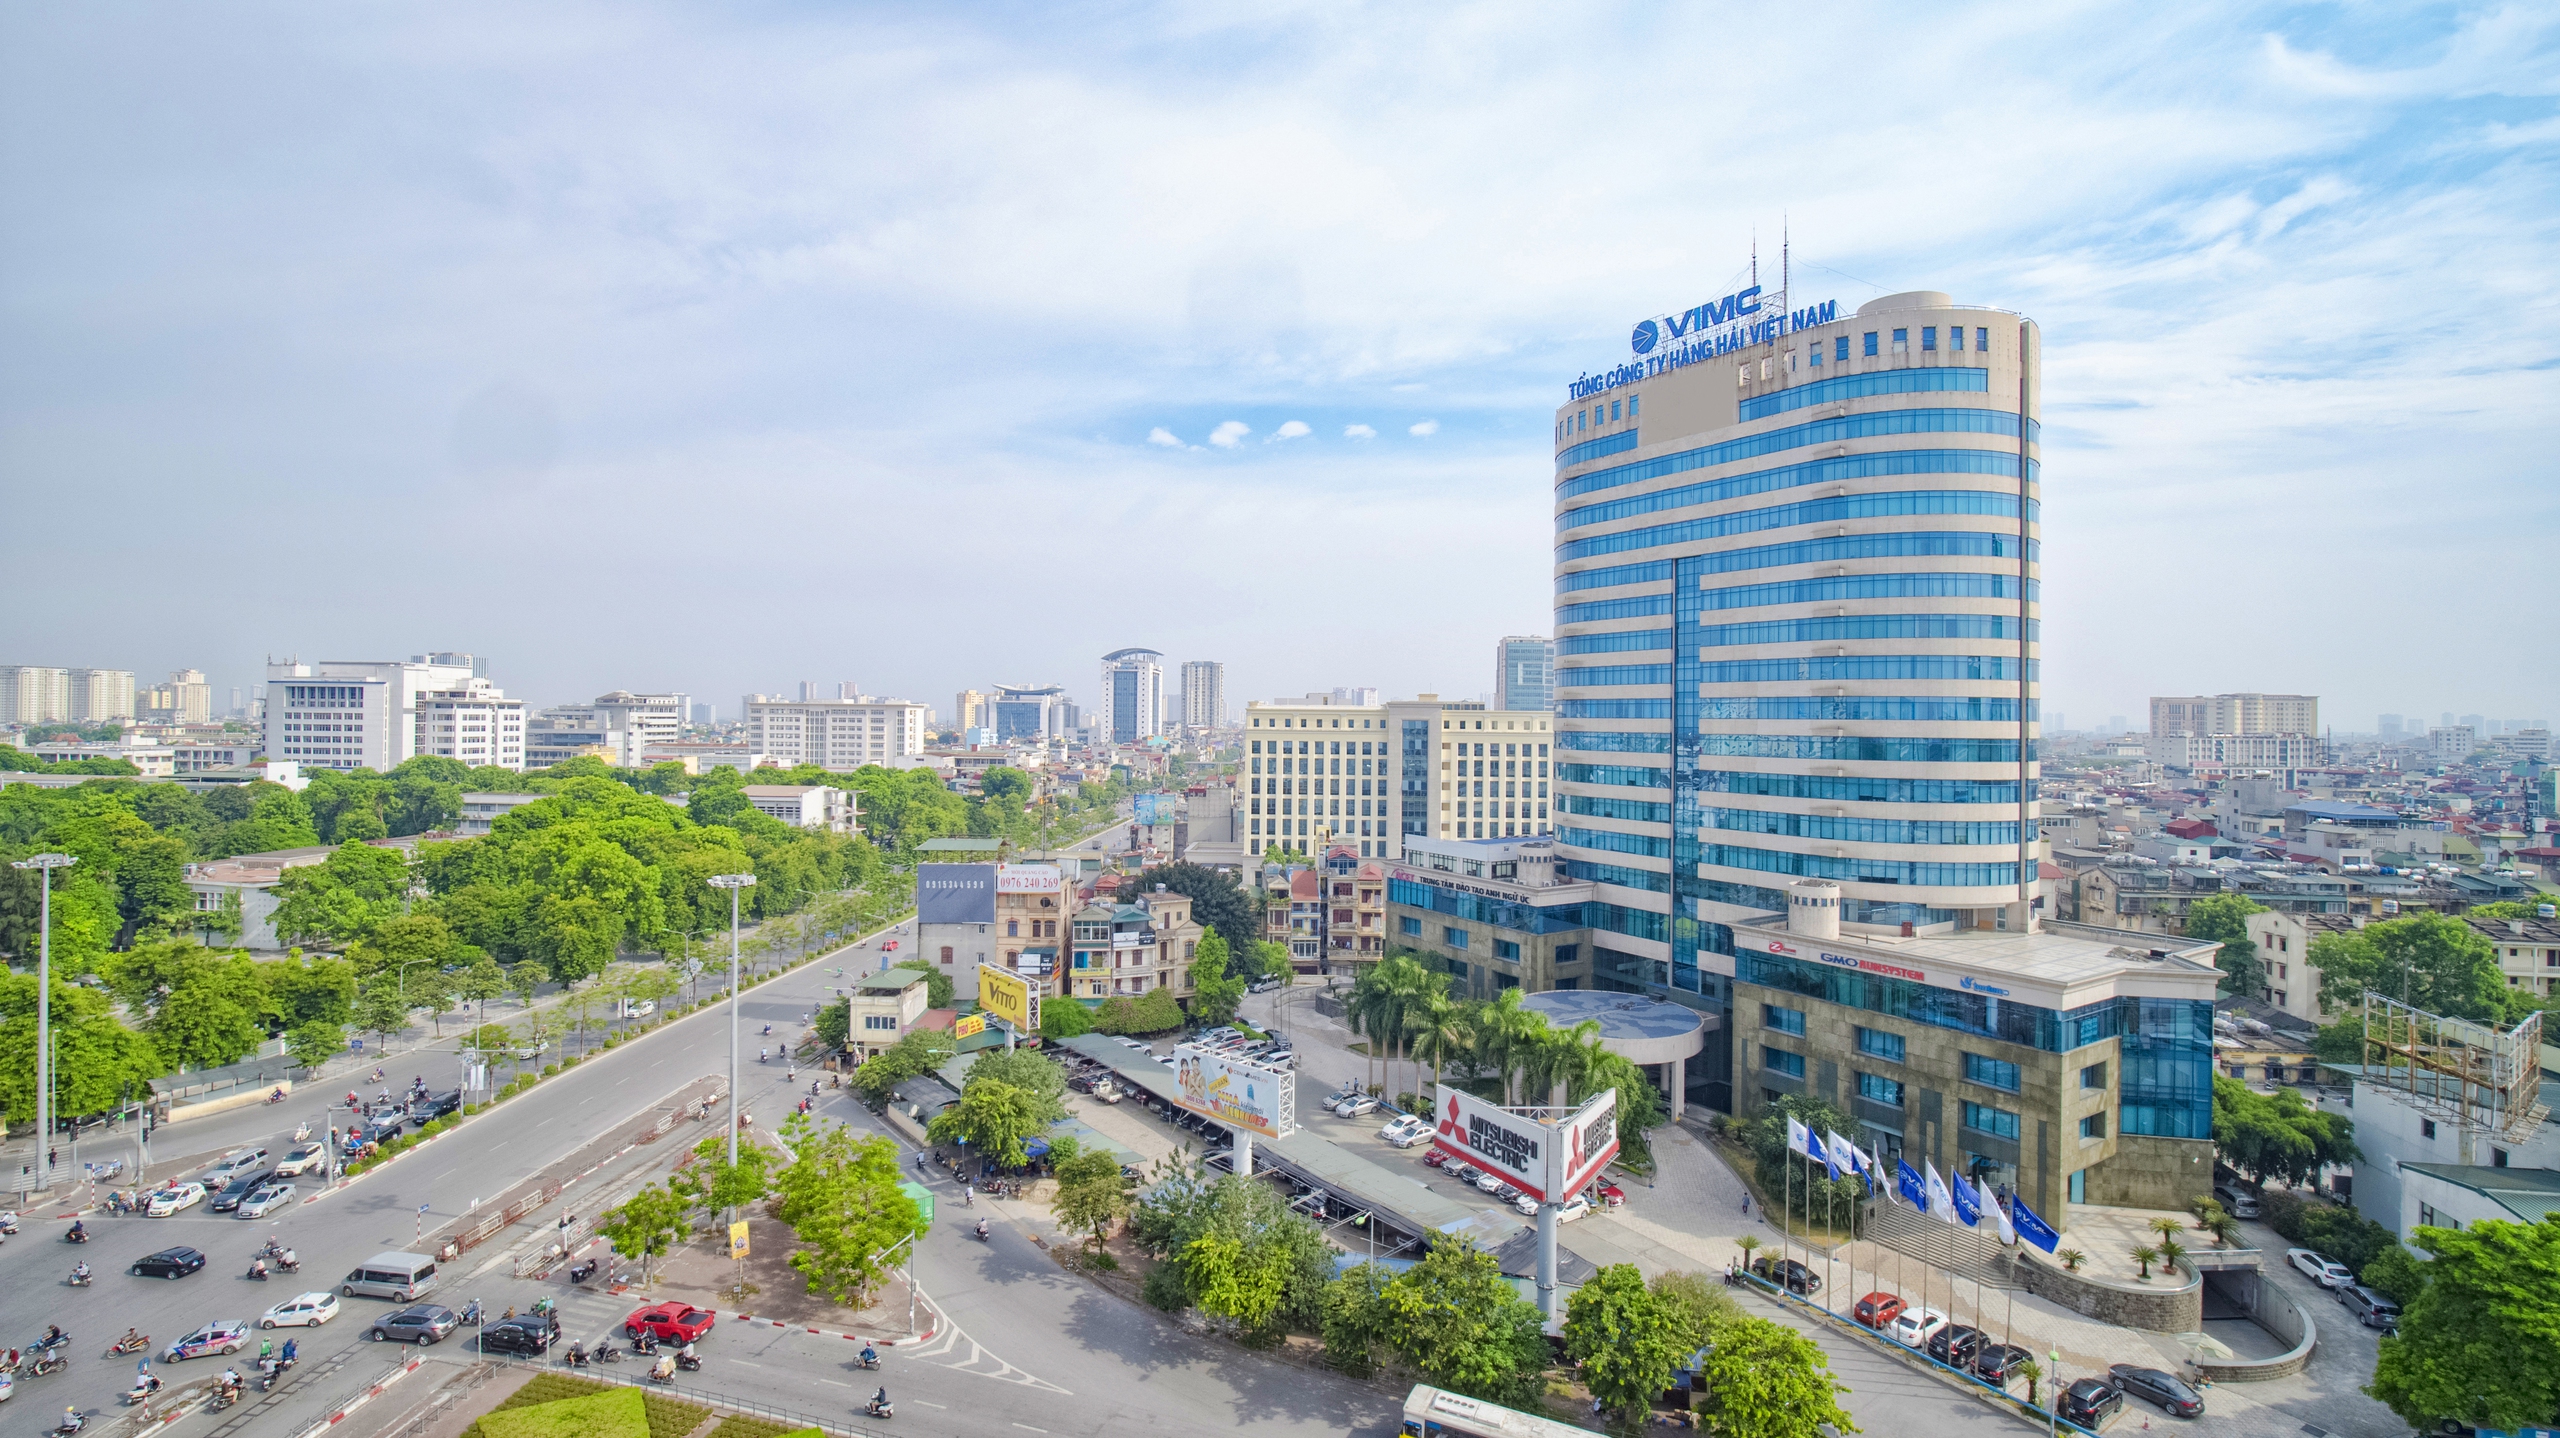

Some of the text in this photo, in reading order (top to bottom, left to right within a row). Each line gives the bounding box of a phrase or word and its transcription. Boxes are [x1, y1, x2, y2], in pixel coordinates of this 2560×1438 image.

[1665, 285, 1761, 338] VIMC
[1569, 299, 1835, 400] TỔNG CÔNG TY HÀNG HẢI VIỆT NAM
[1000, 877, 1058, 888] 0976 240 269
[1419, 876, 1439, 886] TRUNG
[1486, 889, 1500, 898] ANH
[1820, 953, 1925, 981] GMO RUNSYSTEM
[1470, 1113, 1538, 1159] MITSUBISHI
[1470, 1132, 1528, 1173] ELECTRIC
